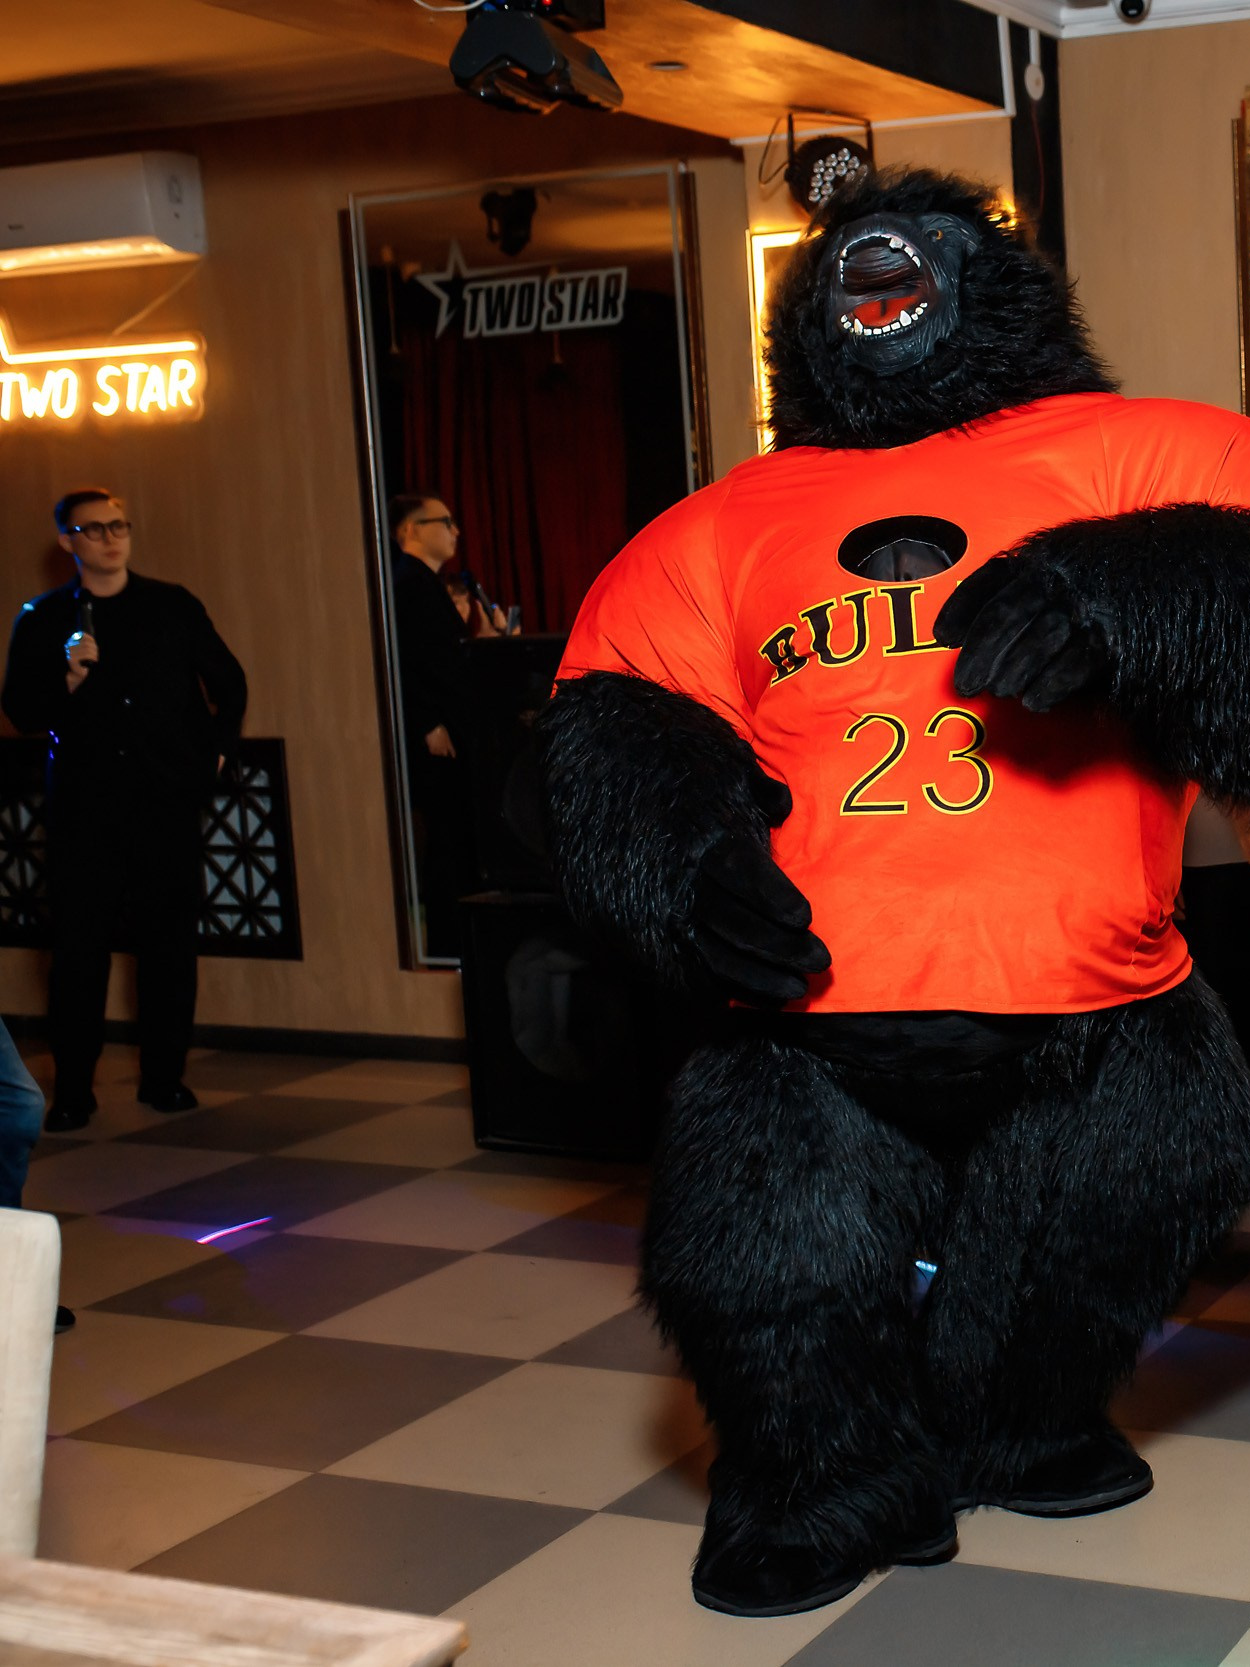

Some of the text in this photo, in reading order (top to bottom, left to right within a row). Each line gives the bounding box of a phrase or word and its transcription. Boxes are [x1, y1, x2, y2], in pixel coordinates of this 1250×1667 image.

[466, 268, 626, 336] TWO STAR
[0, 358, 197, 421] TWO STAR
[758, 581, 964, 688] BUL
[839, 706, 995, 817] 23
